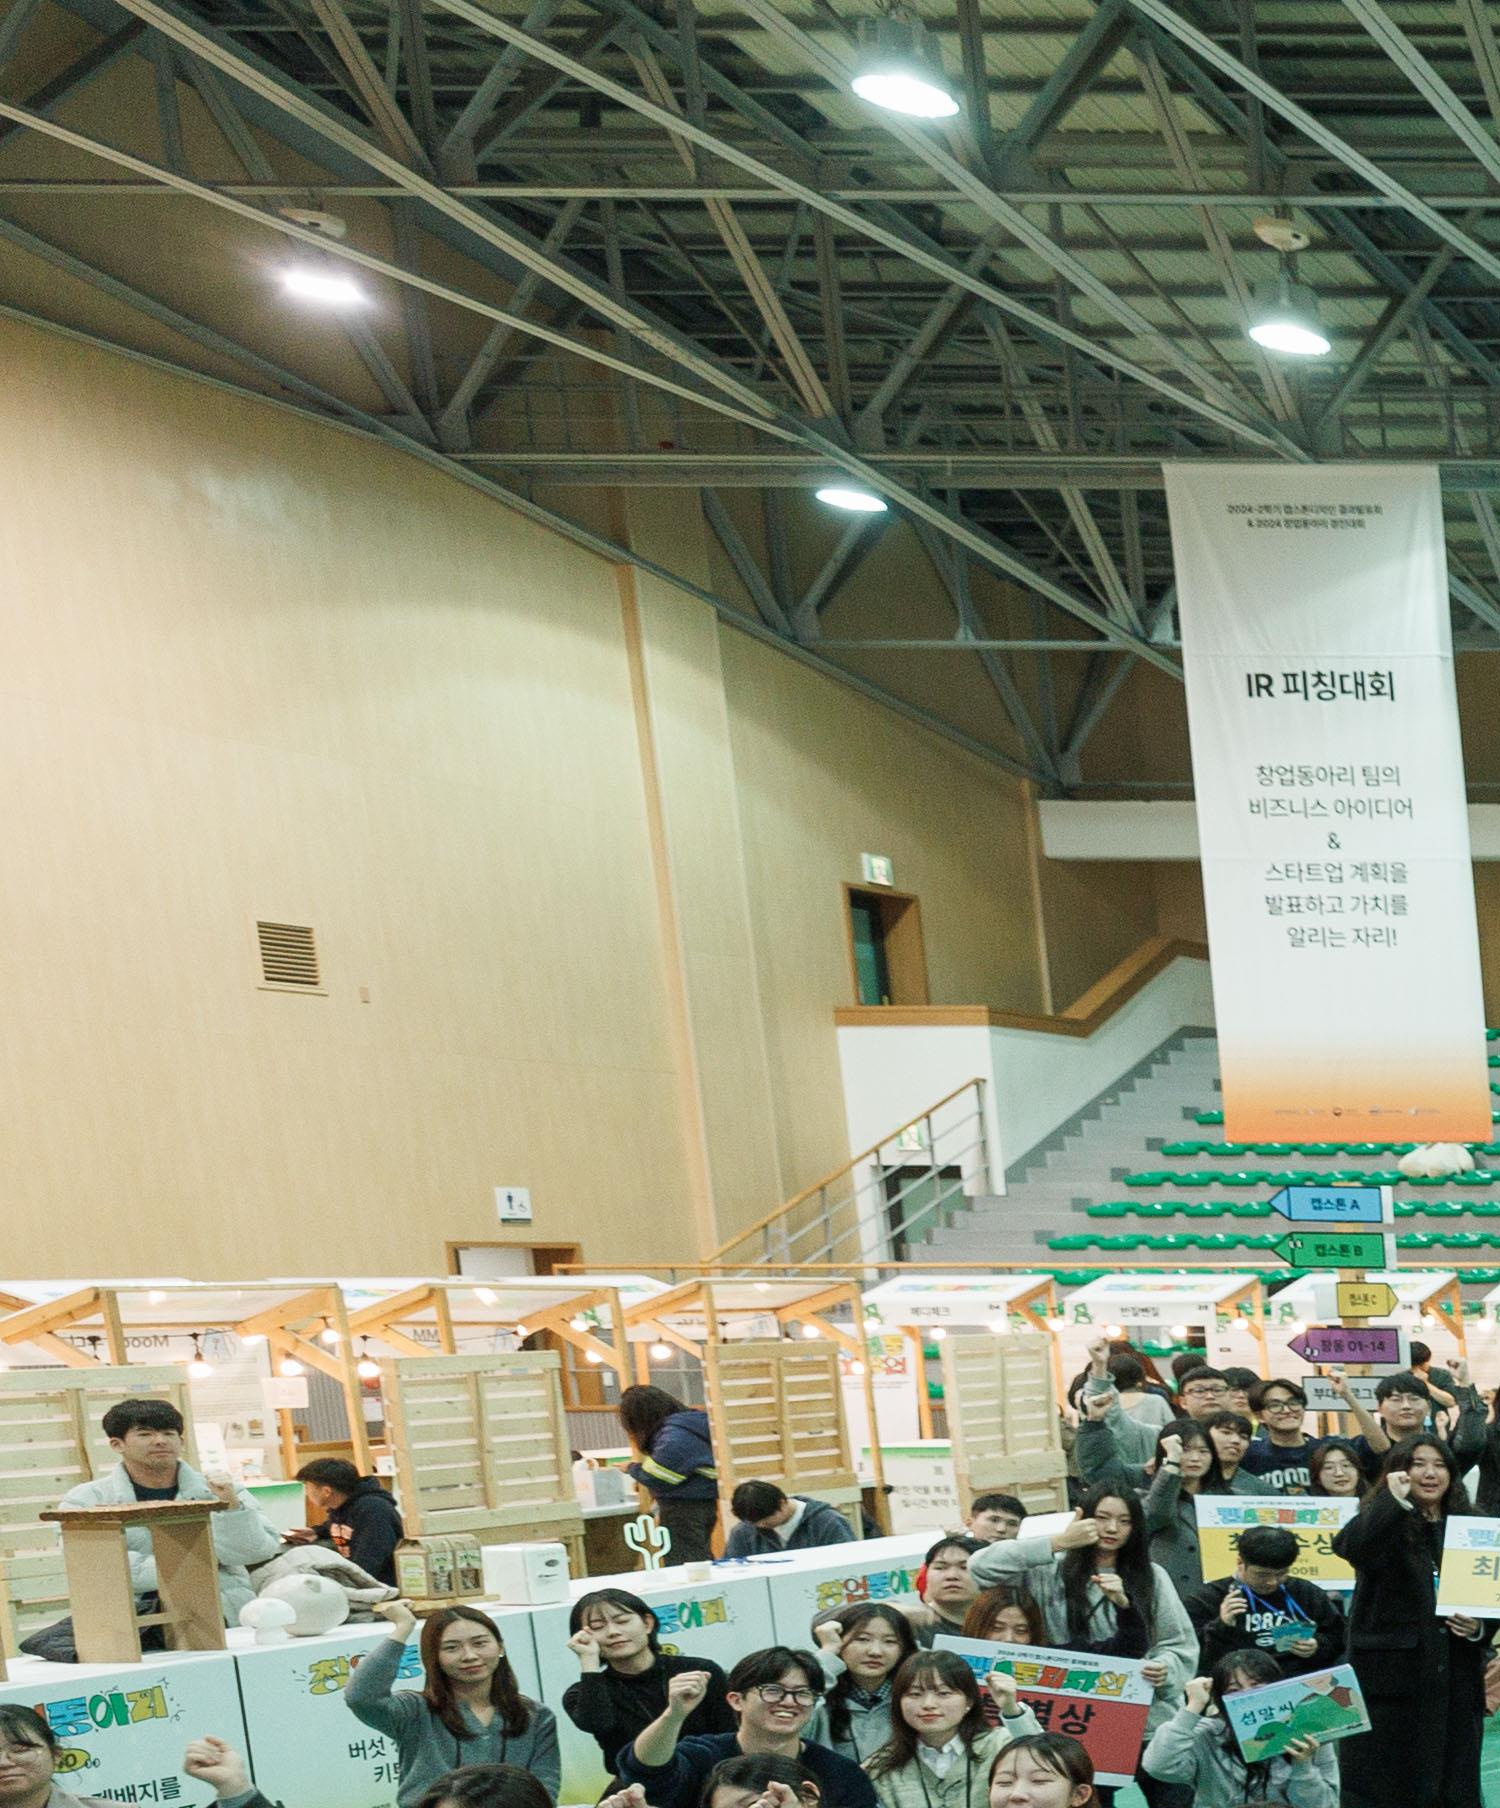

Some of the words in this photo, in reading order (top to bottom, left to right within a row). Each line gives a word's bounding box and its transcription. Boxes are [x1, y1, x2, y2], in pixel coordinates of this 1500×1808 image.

[1247, 672, 1274, 699] IR
[1282, 671, 1395, 703] 피칭대회
[1255, 765, 1356, 788] 창업동아리
[1361, 765, 1401, 788] 팀의
[1248, 798, 1329, 820] 비즈니스
[1333, 798, 1413, 820] 아이디어
[1327, 831, 1341, 852] &
[1264, 862, 1344, 884] 스타트업
[1349, 862, 1408, 884] 계획을
[1264, 893, 1344, 917] 발표하고
[1350, 894, 1409, 917] 가치를
[1287, 926, 1347, 948] 알리는
[1351, 926, 1398, 948] 자리!
[1311, 1197, 1347, 1212] 캡스톤
[1350, 1199, 1360, 1210] A
